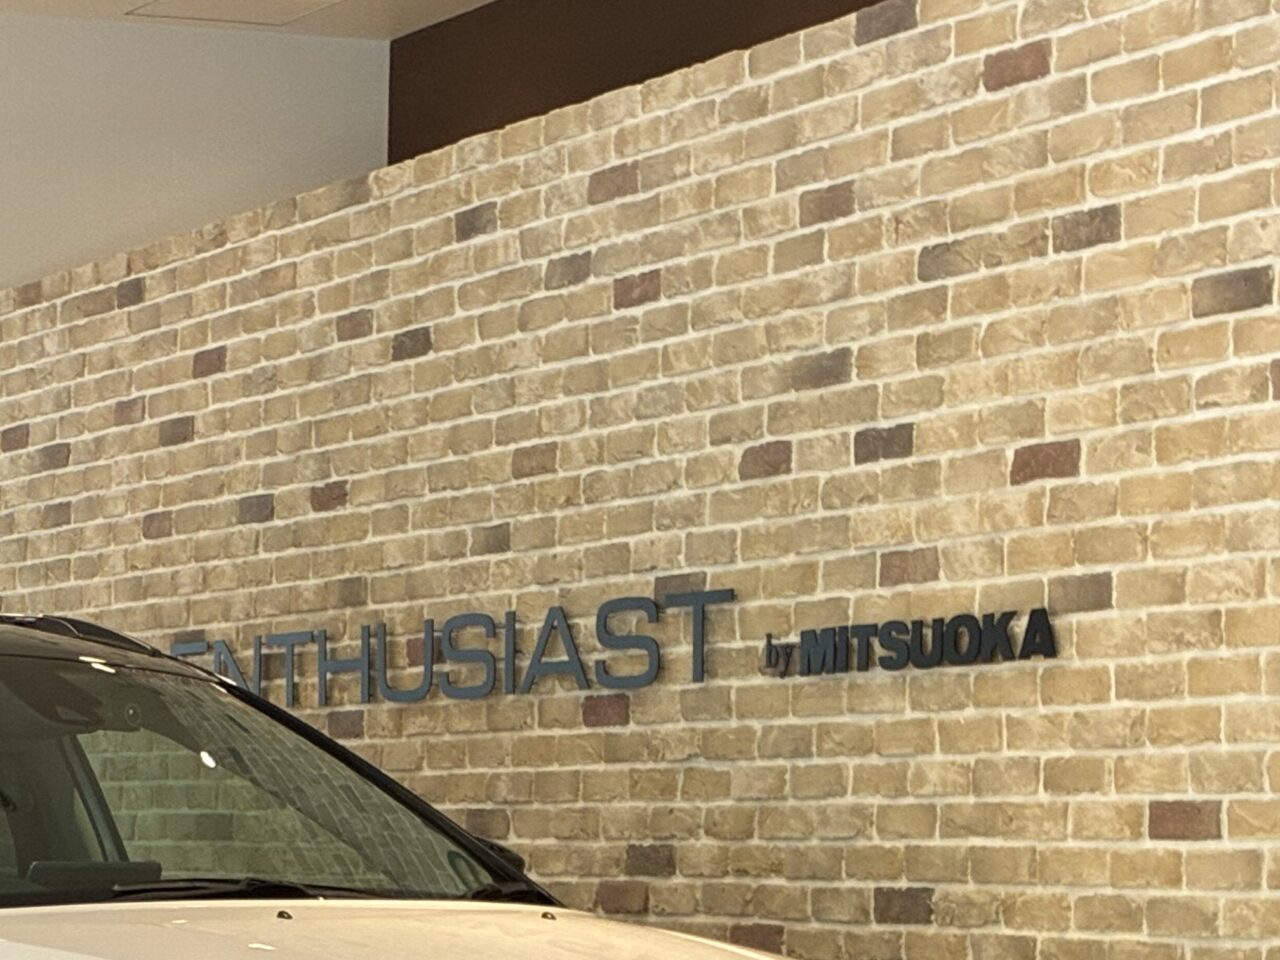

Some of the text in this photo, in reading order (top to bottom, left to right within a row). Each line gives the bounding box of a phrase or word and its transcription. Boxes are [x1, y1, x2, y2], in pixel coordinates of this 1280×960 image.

[173, 588, 1057, 707] NTHUSIAST by MITSUOKA
